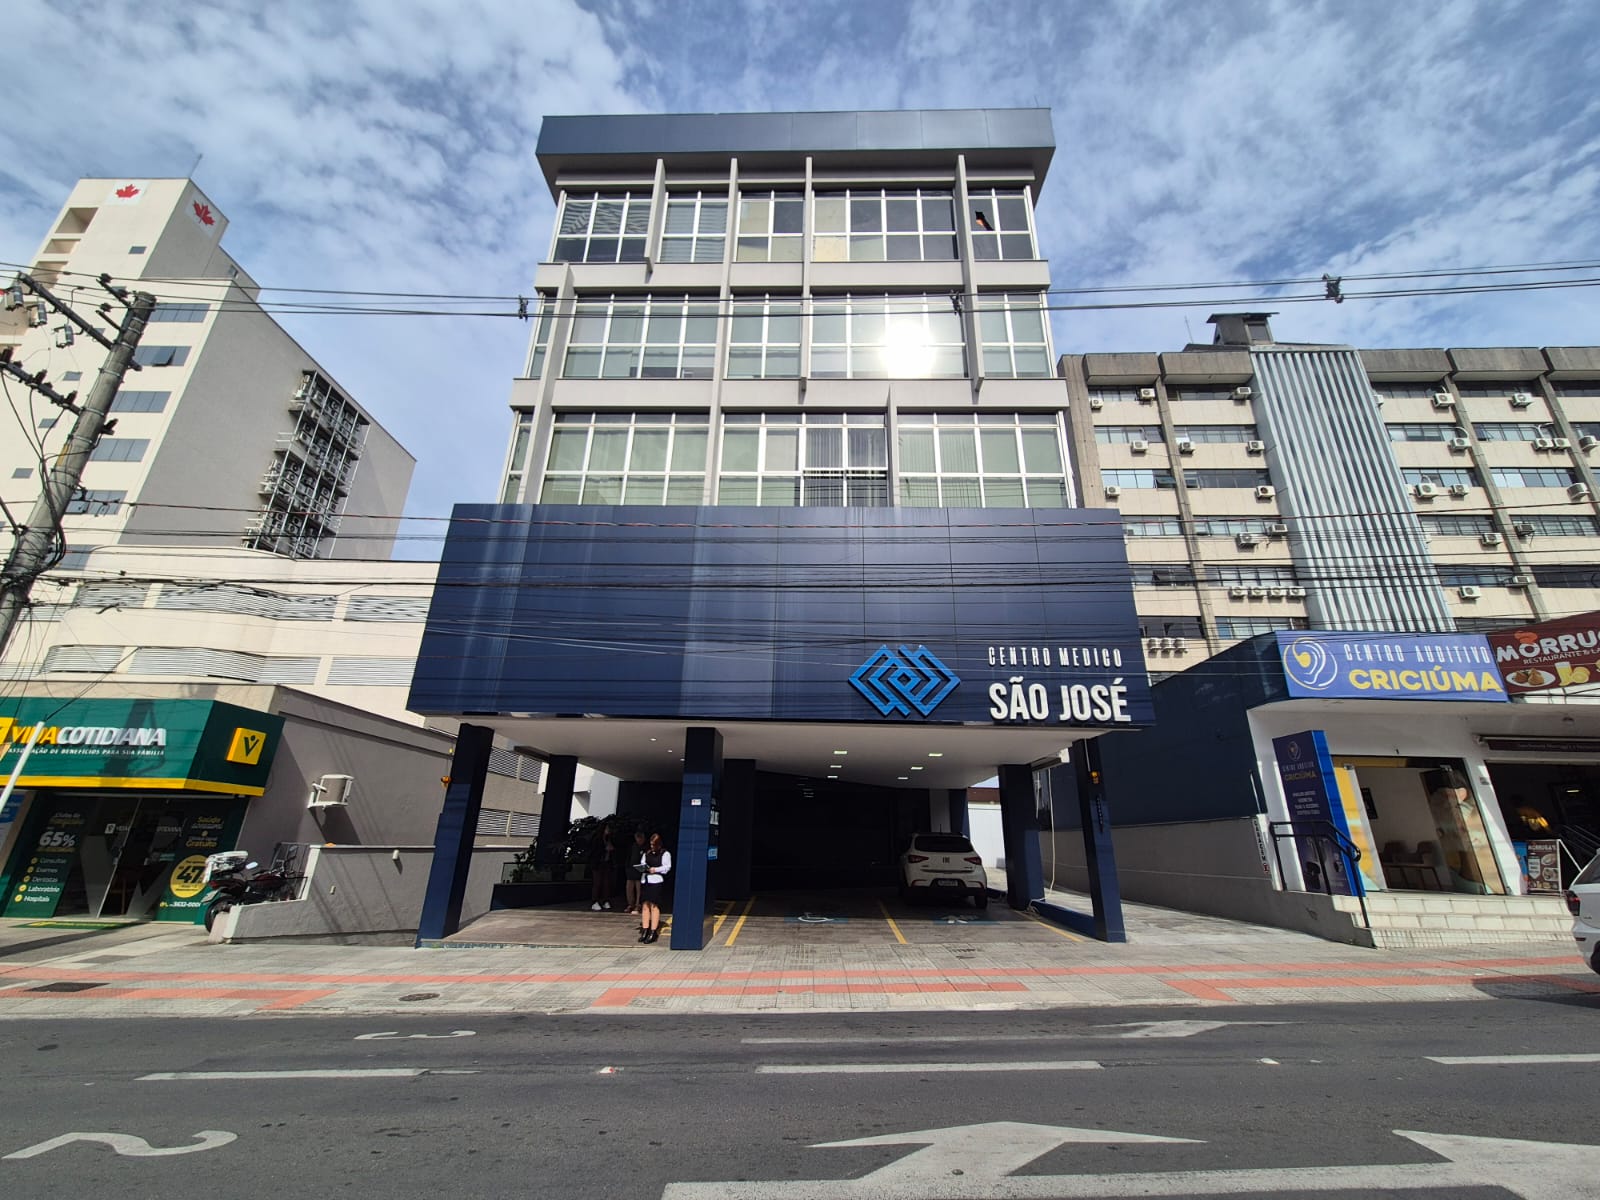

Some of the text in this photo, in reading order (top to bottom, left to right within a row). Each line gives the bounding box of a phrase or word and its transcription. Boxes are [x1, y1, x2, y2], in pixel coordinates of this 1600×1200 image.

[988, 646, 1122, 667] CENTRO MEDICO
[1344, 643, 1490, 664] CENTRO AUDITIVO
[1496, 630, 1600, 663] MORRU
[1523, 650, 1582, 665] RESTAURANTE
[1348, 665, 1503, 693] CRICIÚMA
[988, 676, 1132, 722] SÃO JOSÉ
[61, 747, 100, 755] BENEFÍCIOS
[39, 831, 76, 848] 65%
[176, 865, 205, 884] 47
